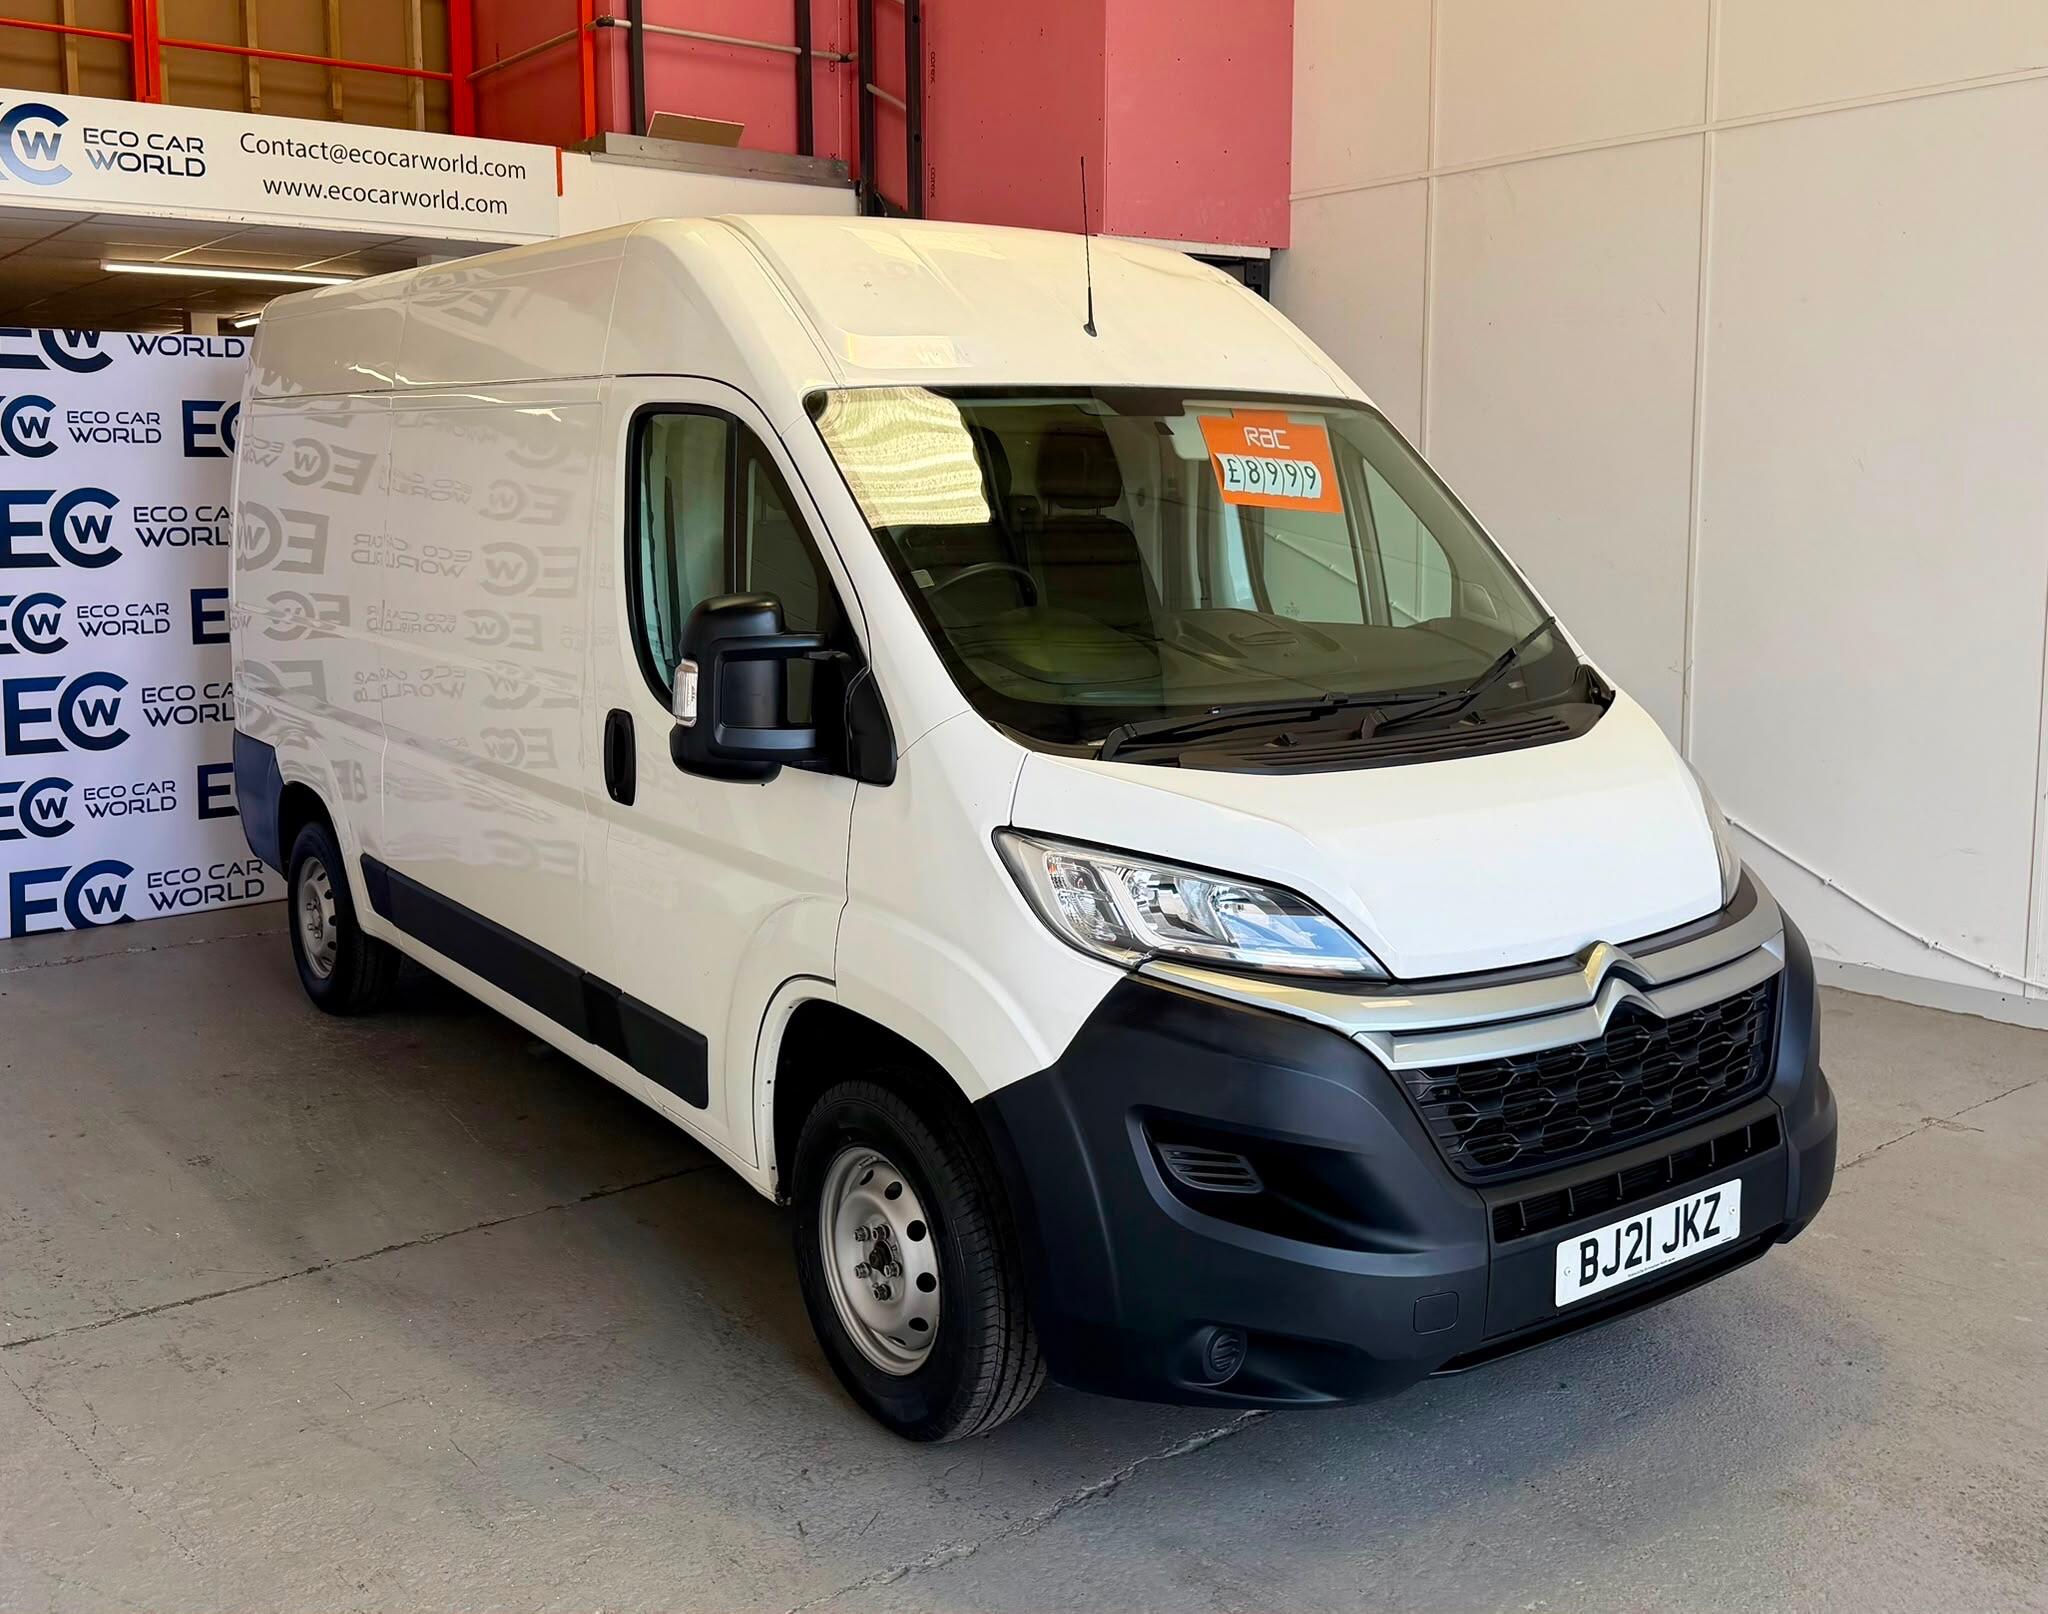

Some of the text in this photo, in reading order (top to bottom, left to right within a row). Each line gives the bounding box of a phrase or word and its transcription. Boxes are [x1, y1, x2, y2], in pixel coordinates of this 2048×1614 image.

[83, 127, 205, 154] ECO CAR
[85, 148, 206, 178] WORLD
[240, 132, 527, 180] Contact@ecocarworld.com
[263, 176, 508, 215] www.ecocarworld.com
[127, 334, 245, 358] WORLD
[67, 411, 161, 425] ECO CAR
[69, 427, 162, 444] WORLD
[1227, 458, 1316, 490] £8999
[133, 507, 229, 523] ECO CA
[135, 527, 229, 547] WORL
[77, 603, 170, 618] ECO CAR
[79, 619, 171, 637] WORLD
[142, 683, 234, 703] ECO CA
[143, 703, 235, 727] WORL
[84, 780, 176, 800] ECO CAR
[85, 796, 177, 818] WORLD
[147, 859, 264, 888] ECO CAR
[149, 879, 265, 911] WORLD
[1579, 1192, 1721, 1287] BJ21 JKZ
